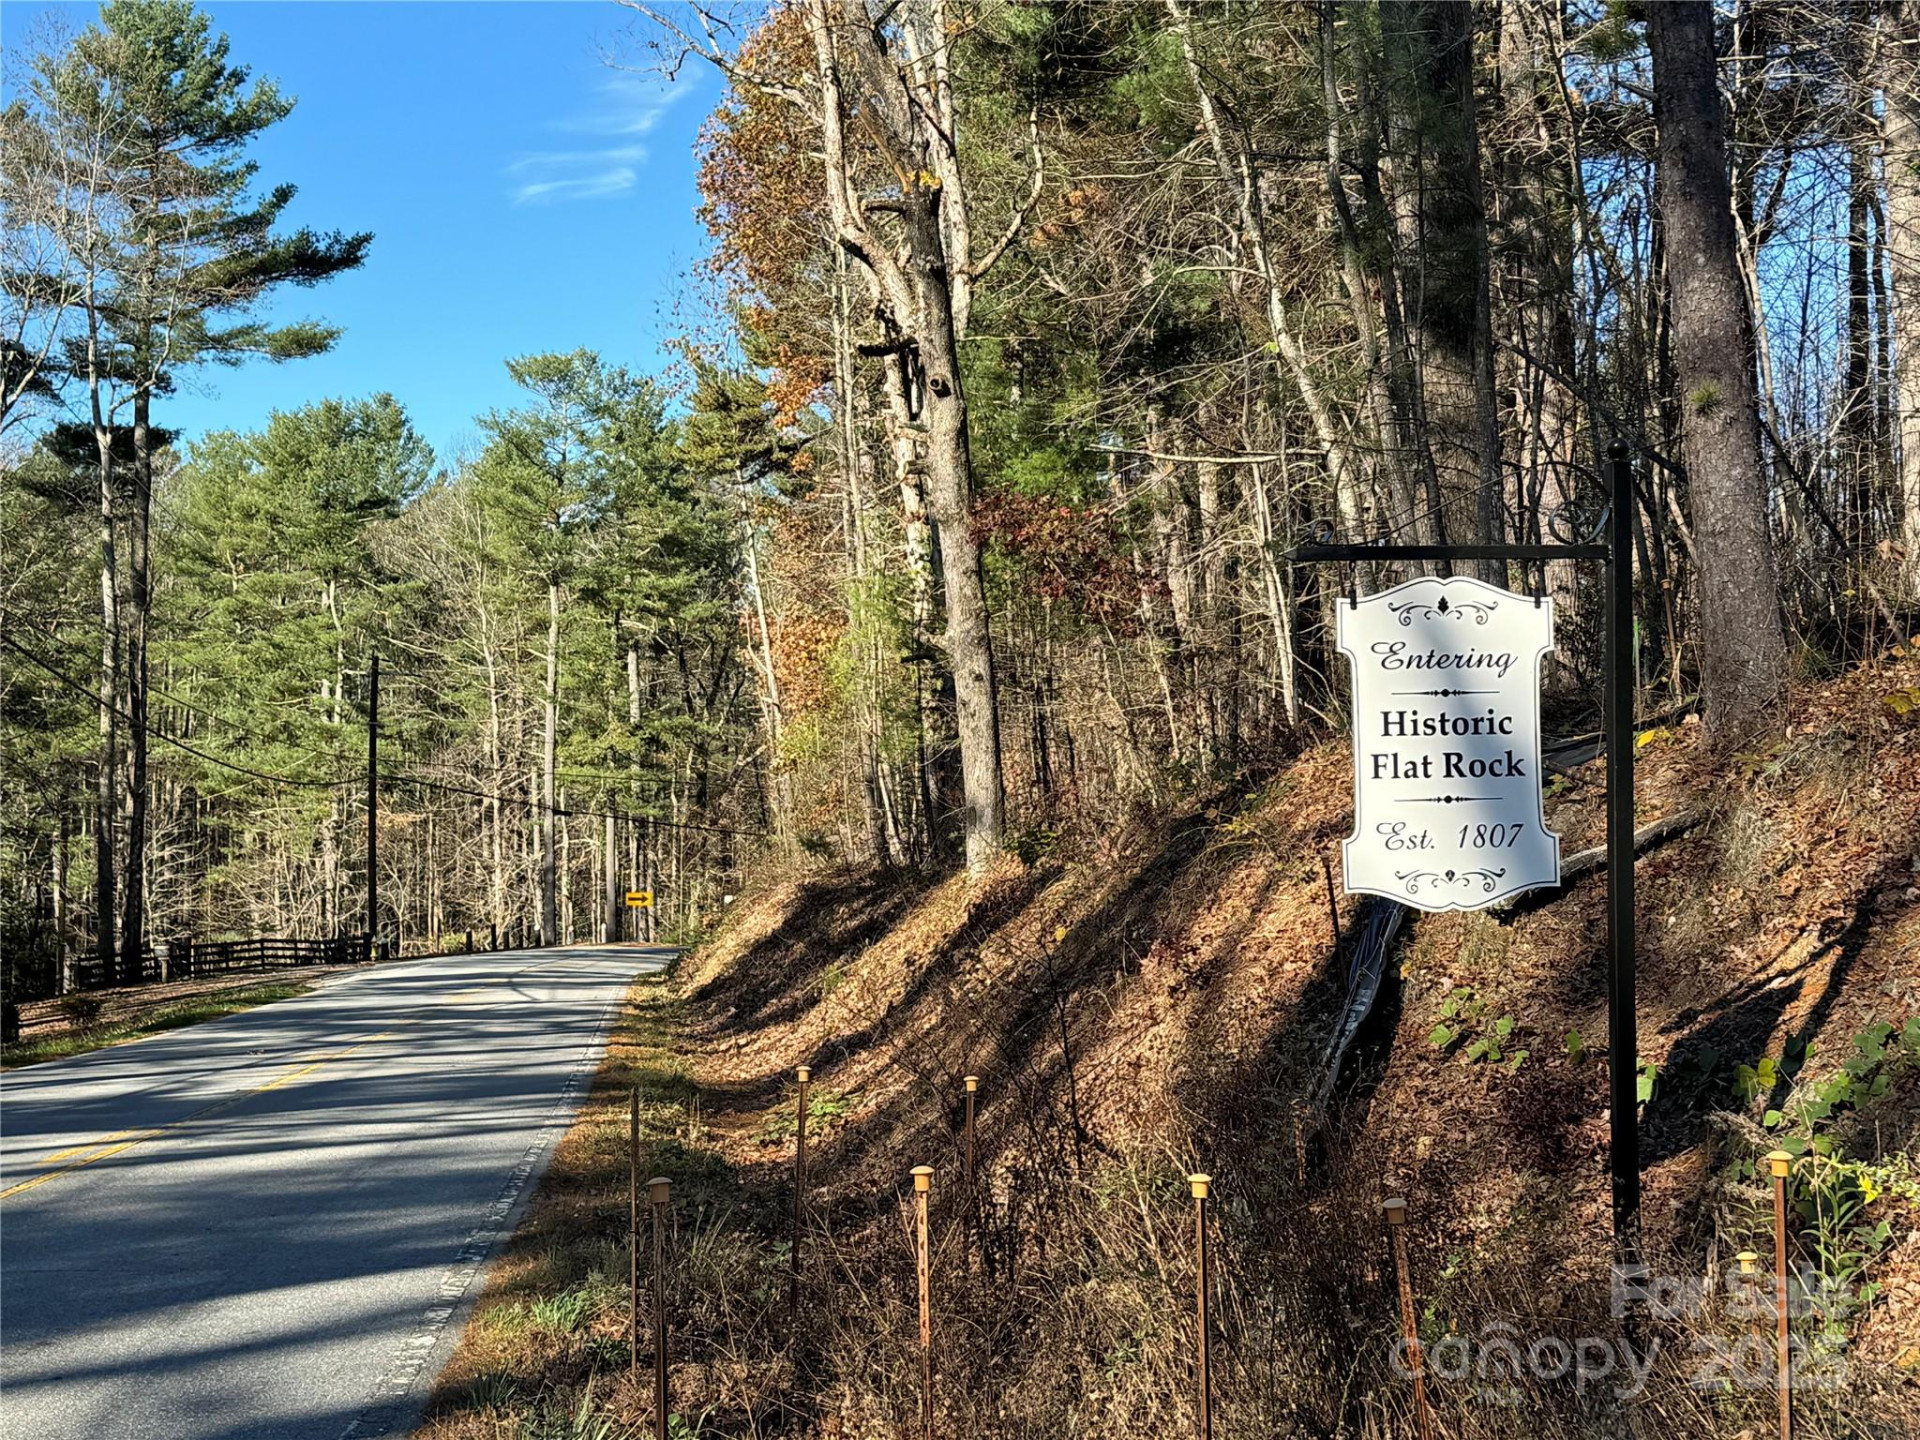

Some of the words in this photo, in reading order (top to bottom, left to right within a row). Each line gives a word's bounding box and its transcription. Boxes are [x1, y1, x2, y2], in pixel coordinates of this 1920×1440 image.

[1371, 641, 1518, 678] Entering
[1380, 708, 1513, 737] Historic
[1371, 752, 1432, 780] Flat
[1442, 750, 1526, 779] Rock
[1376, 822, 1435, 851] Est.
[1458, 822, 1525, 849] 1807
